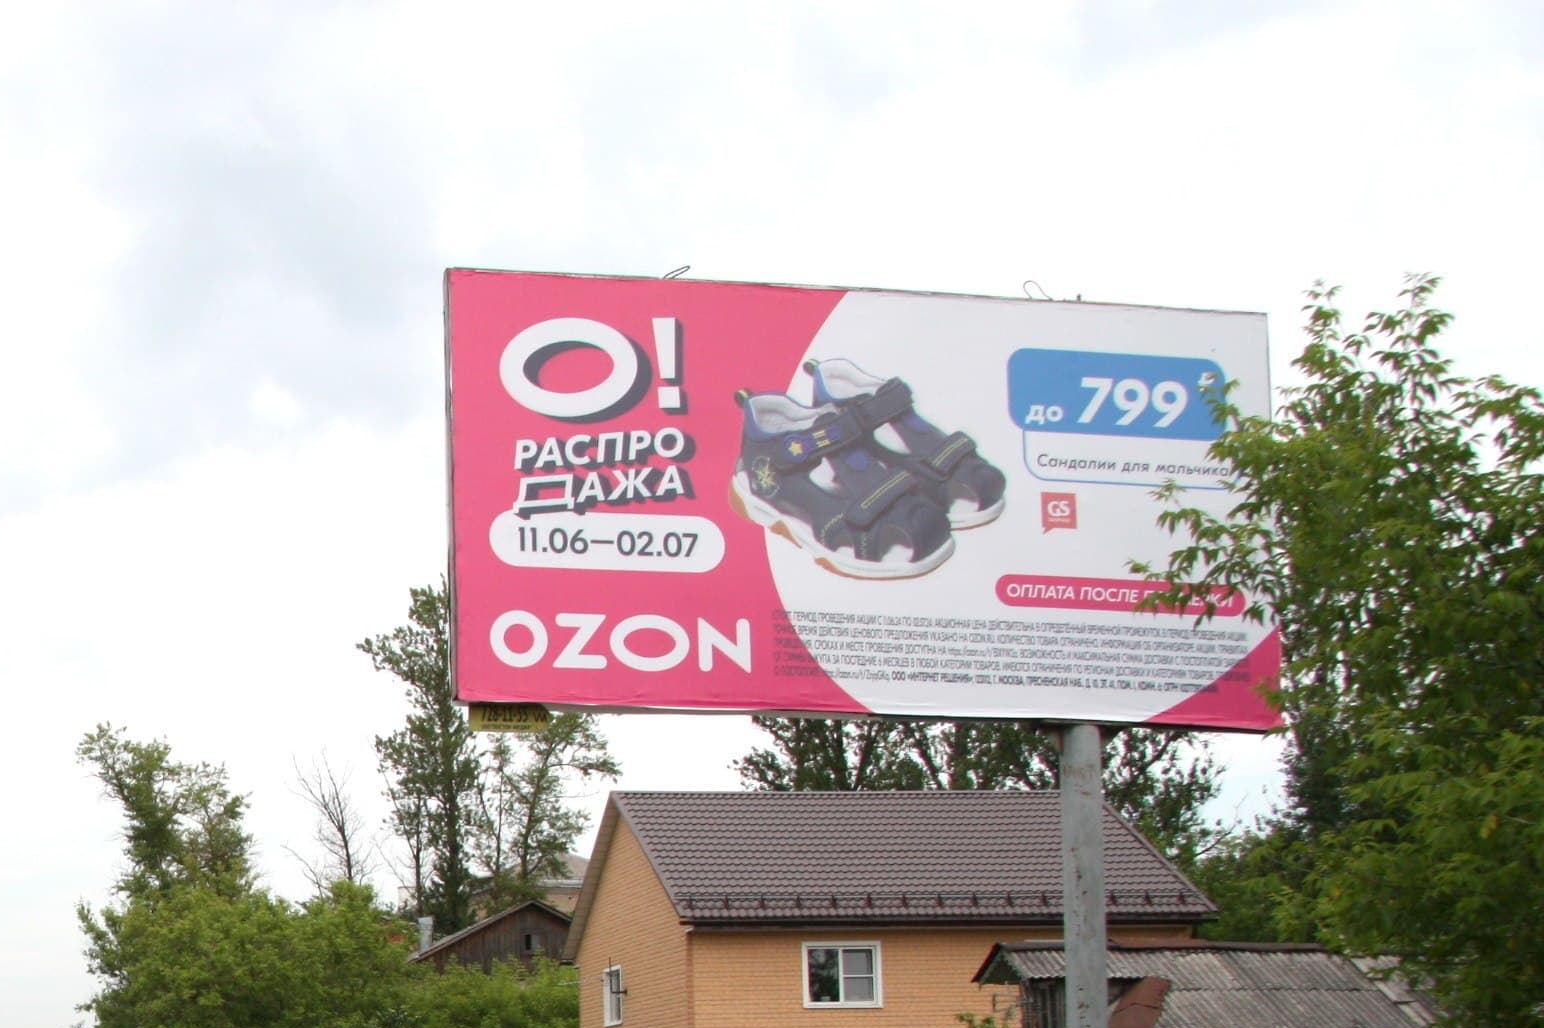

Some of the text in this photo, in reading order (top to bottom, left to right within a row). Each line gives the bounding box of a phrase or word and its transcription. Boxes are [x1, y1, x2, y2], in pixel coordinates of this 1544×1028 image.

[1024, 404, 1064, 425] до
[1077, 376, 1188, 428] 799
[514, 427, 686, 470] РАСПРО
[1037, 453, 1117, 472] Сандалии
[1121, 461, 1150, 474] для
[512, 465, 685, 514] ДАЖА
[1006, 583, 1075, 600] ОПЛАТА
[1079, 586, 1139, 604] ПОСЛЕ
[489, 609, 752, 674] OZON
